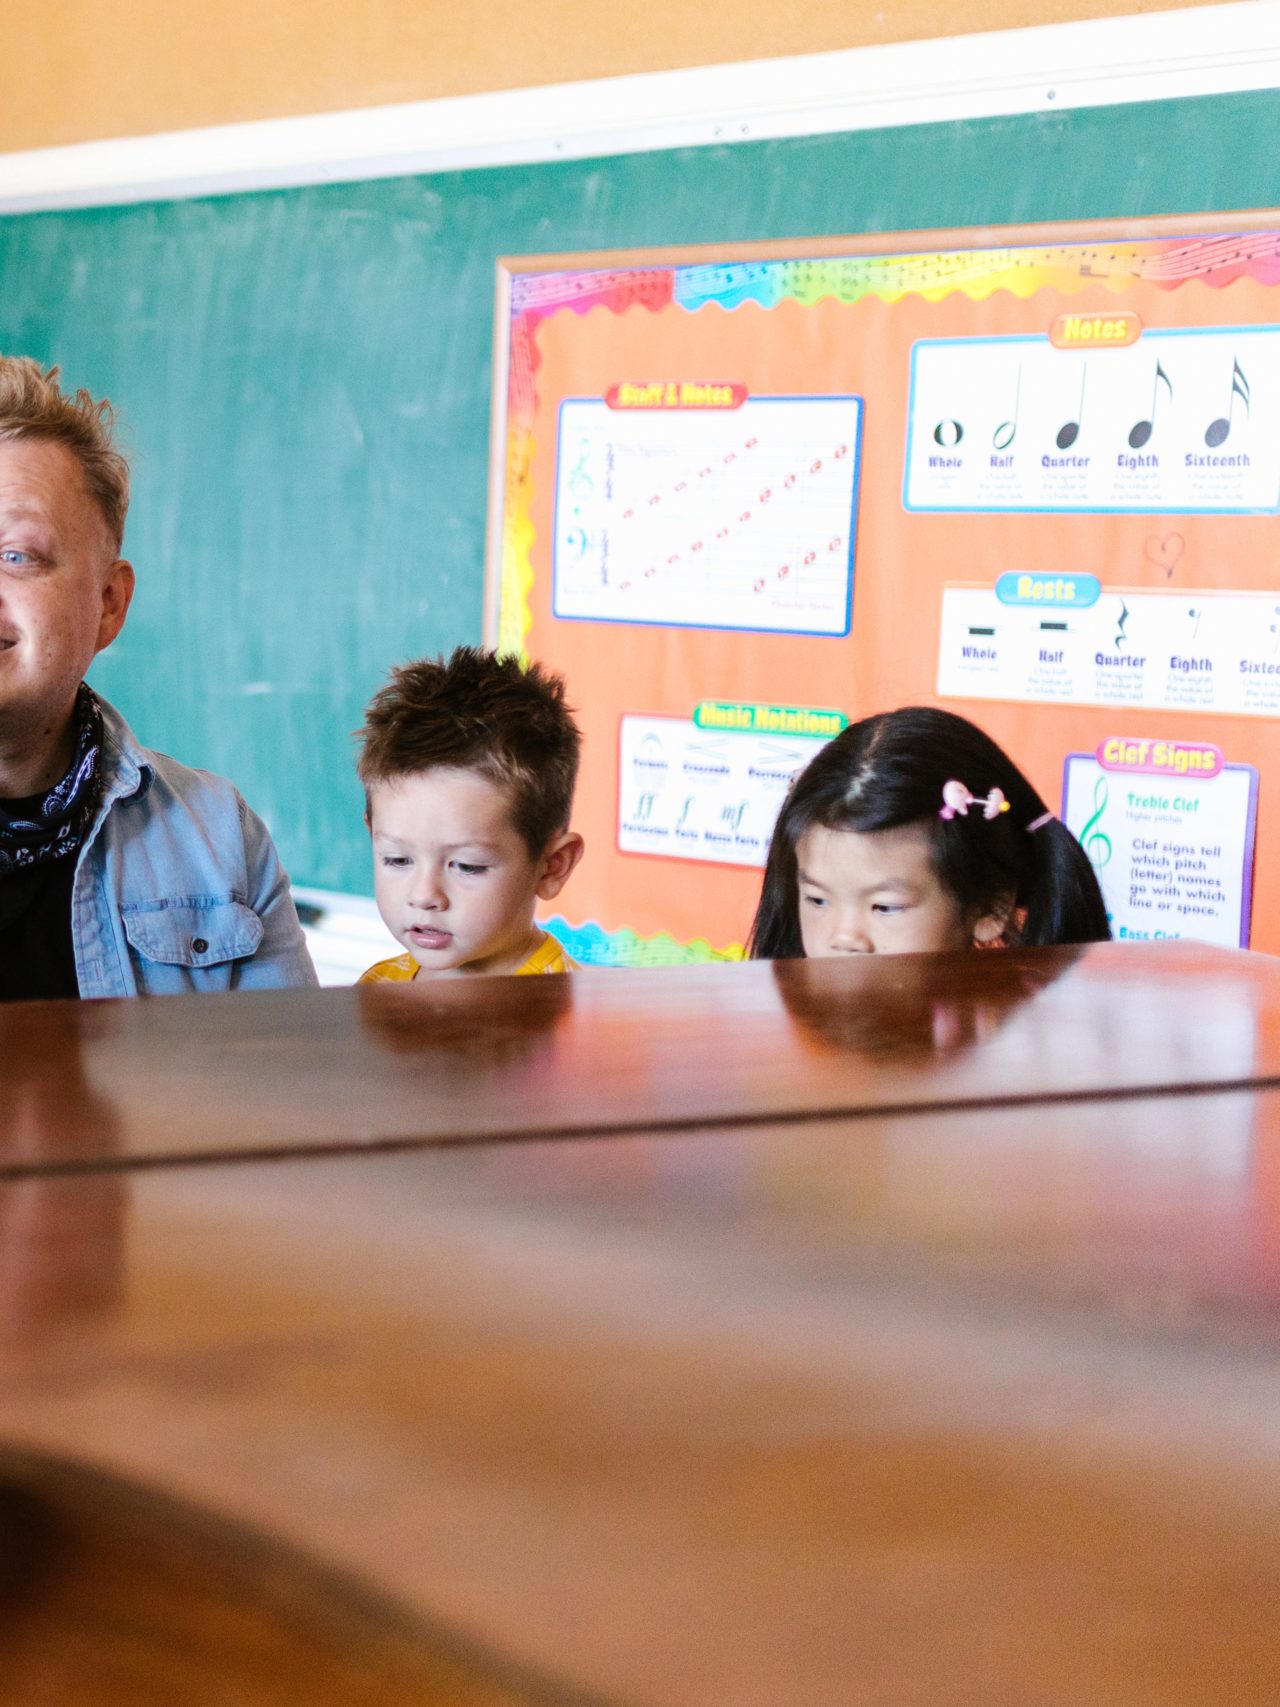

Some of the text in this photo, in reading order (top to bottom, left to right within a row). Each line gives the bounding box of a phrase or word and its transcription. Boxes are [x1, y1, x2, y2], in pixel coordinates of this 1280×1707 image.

[1065, 317, 1126, 340] Notes
[619, 384, 662, 406] Staff
[681, 384, 732, 404] Notes
[929, 456, 963, 467] Whole
[990, 455, 1014, 467] Half
[1041, 454, 1091, 468] Quarter
[1117, 454, 1159, 470] Eighth
[1185, 453, 1251, 467] Sixteenth
[1018, 576, 1076, 600] Rests
[962, 646, 997, 660] Whole
[1039, 649, 1064, 663] Half
[1094, 652, 1147, 668] Quarter
[1170, 656, 1213, 673] Eighth
[700, 702, 841, 734] Music Notations
[1104, 739, 1216, 772] Clef Signs
[1127, 792, 1200, 813] Treble Clef
[1132, 840, 1222, 857] Clef signs tell
[1131, 854, 1206, 871] which pitch
[1130, 868, 1222, 888] (letter) names
[1129, 884, 1226, 903] go with which
[1129, 896, 1219, 917] line or space.
[1120, 926, 1149, 941] Bass
